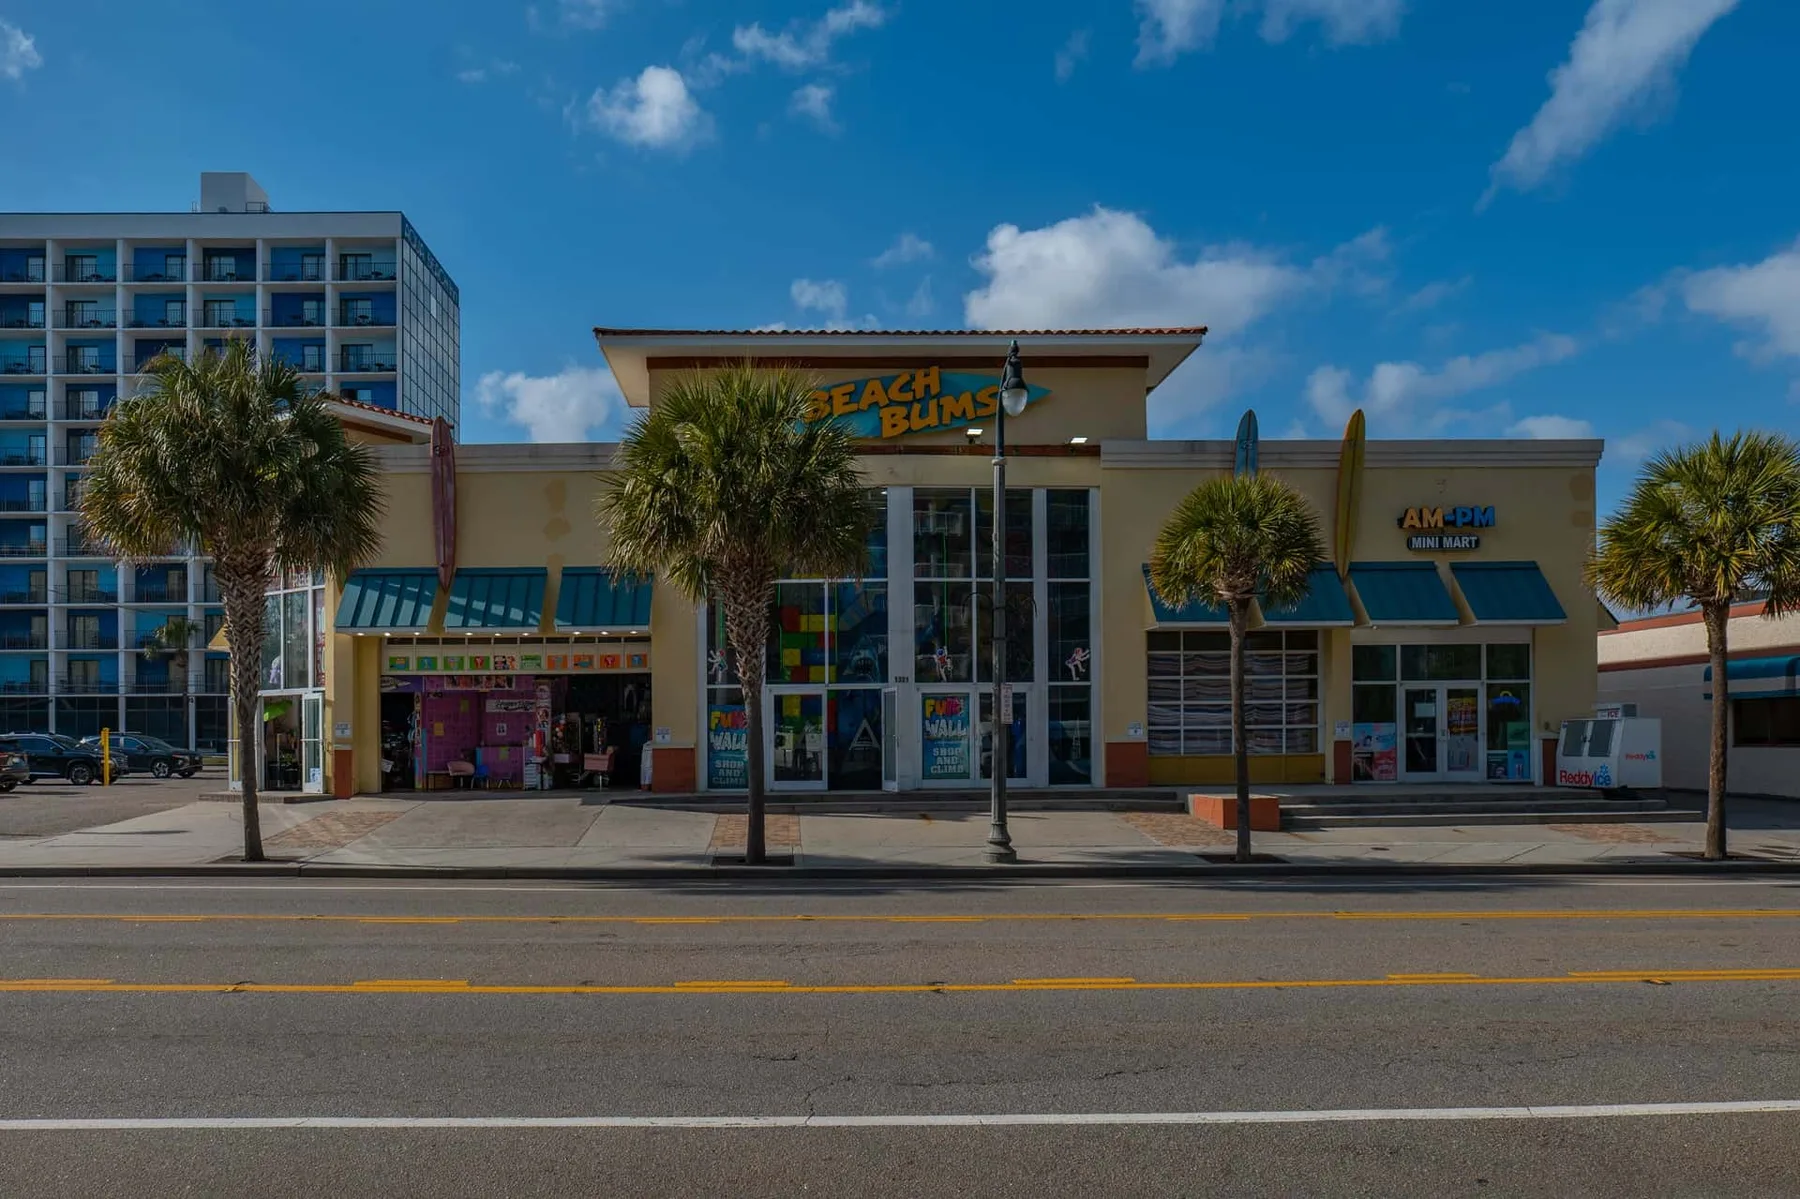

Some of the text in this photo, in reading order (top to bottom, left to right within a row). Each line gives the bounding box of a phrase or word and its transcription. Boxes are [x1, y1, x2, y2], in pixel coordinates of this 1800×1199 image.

[804, 366, 940, 423] BEACH
[880, 385, 999, 438] BUMS
[1402, 505, 1495, 528] AM-PM
[1412, 536, 1477, 548] MINI MART
[925, 719, 967, 737] WALL
[933, 748, 962, 756] SHOP
[936, 756, 958, 765] AND
[930, 765, 964, 773] CLIMB
